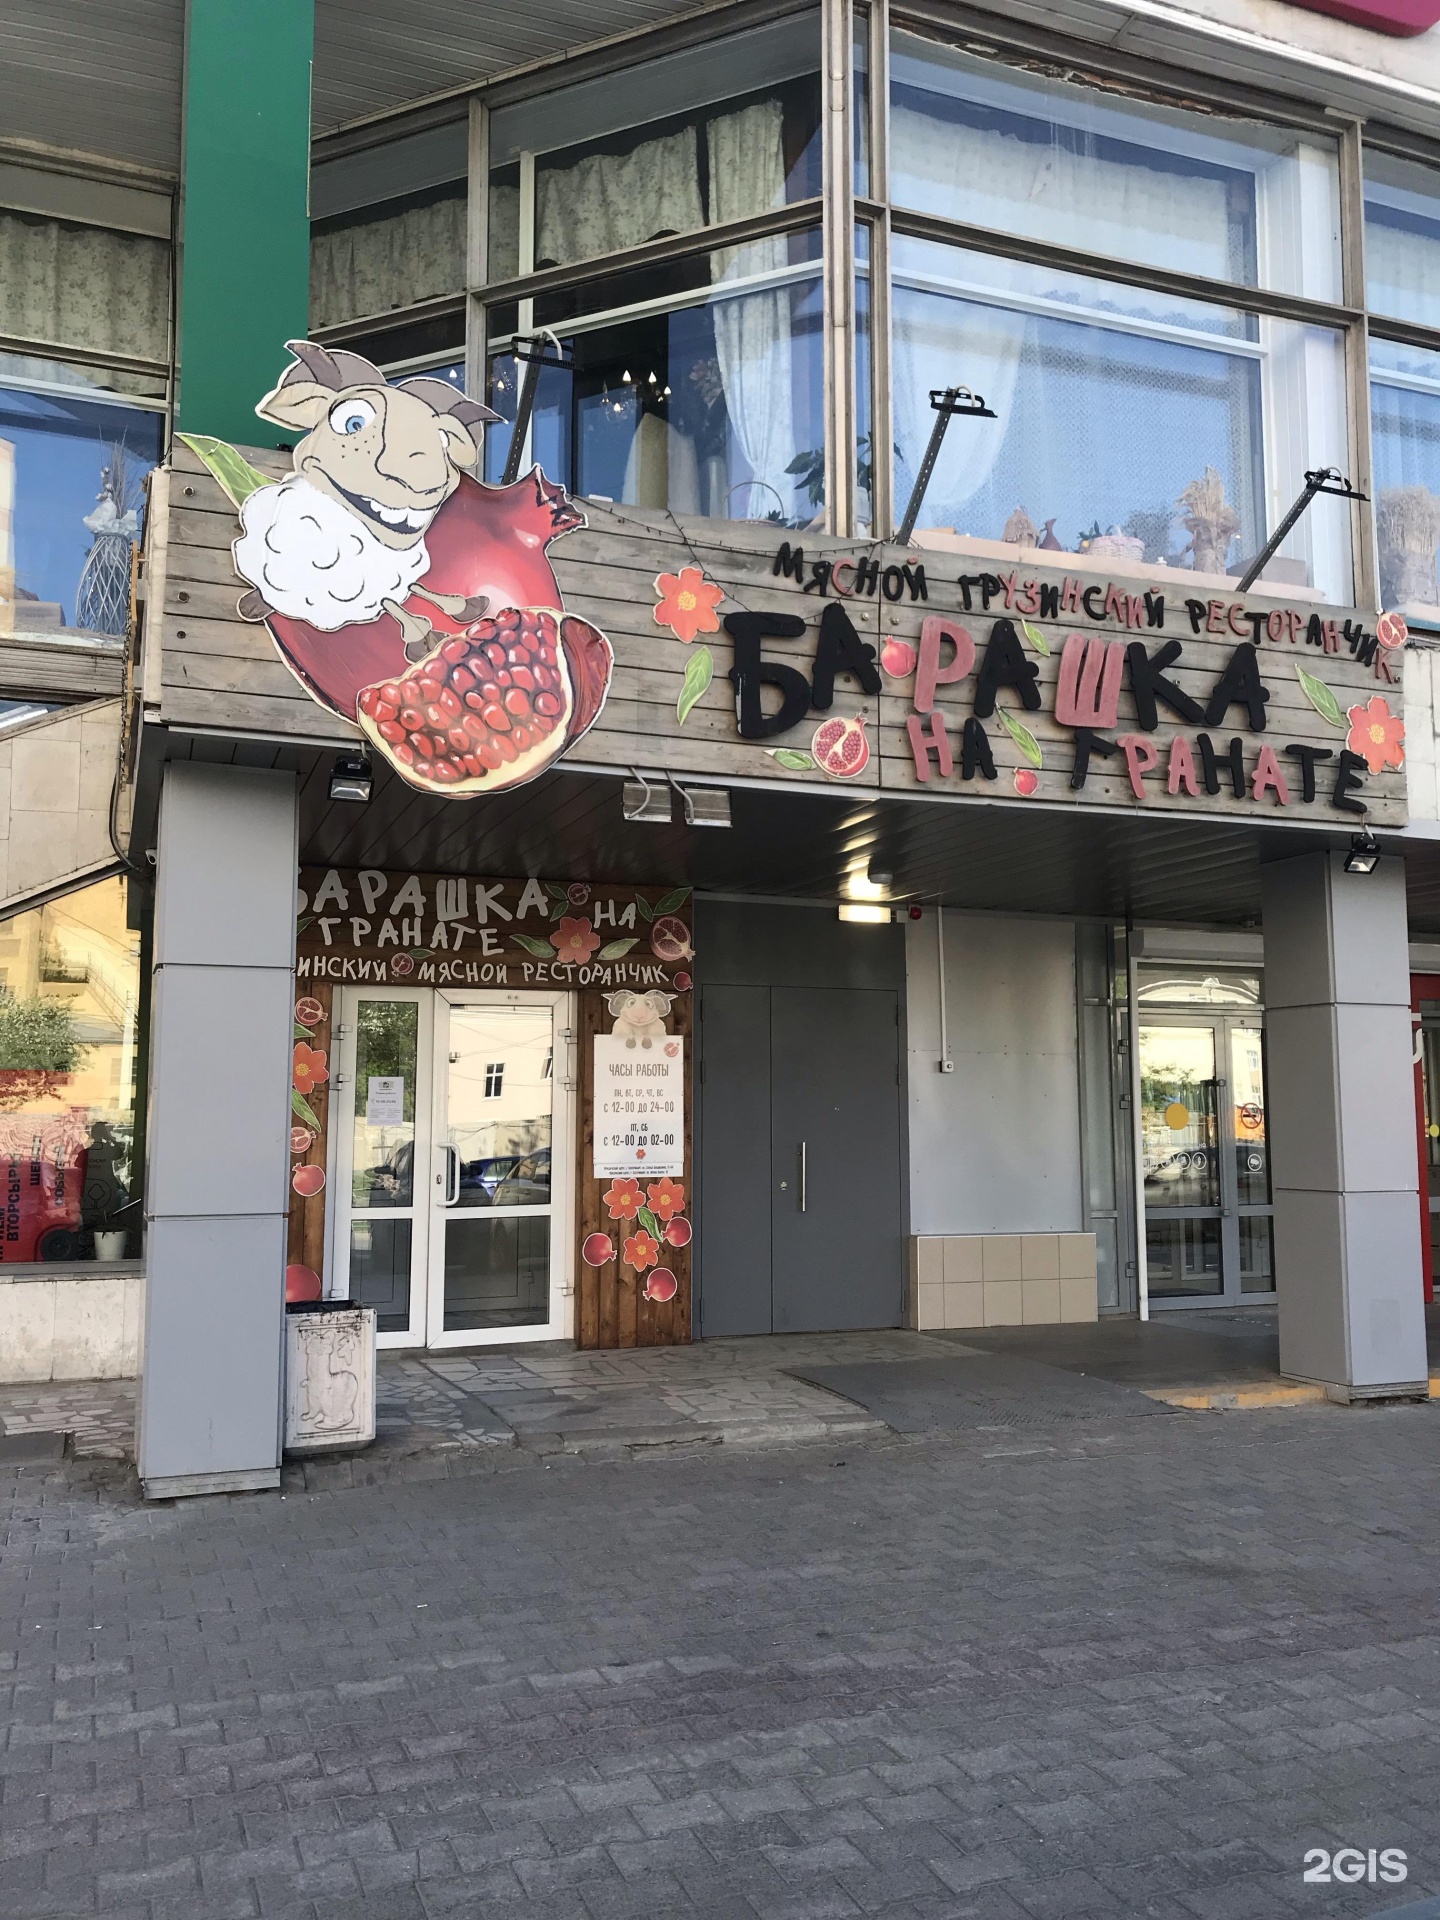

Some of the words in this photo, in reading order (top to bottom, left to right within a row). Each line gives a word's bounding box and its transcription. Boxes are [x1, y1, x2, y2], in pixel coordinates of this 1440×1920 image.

[773, 541, 928, 601] МЯСНОЙ
[957, 569, 1165, 628] ГРУЗИНСКИЙ
[1184, 599, 1393, 684] РЕСТОРАНЧИК
[723, 602, 1270, 739] БАРАШКА
[906, 711, 998, 782] НА
[1070, 728, 1369, 813] ГРАНАТЕ
[297, 866, 549, 923] АРАШКА
[595, 899, 637, 930] НА
[317, 917, 504, 957] ГРАНАТЕ
[417, 959, 508, 984] МЯСНОЙ
[522, 961, 670, 986] РЕСТОРАНЧИК
[608, 1063, 633, 1077] ЧАСЫ
[636, 1063, 669, 1077] РАБОТЫ
[656, 1088, 664, 1097] ВС
[611, 1101, 635, 1113] 12-00
[637, 1102, 648, 1114] до
[650, 1101, 675, 1113] 24-00
[611, 1134, 635, 1147] 12-00
[637, 1135, 648, 1147] до
[650, 1133, 674, 1146] 02-00
[630, 1123, 639, 1133] ПТ,
[640, 1123, 649, 1132] СБ
